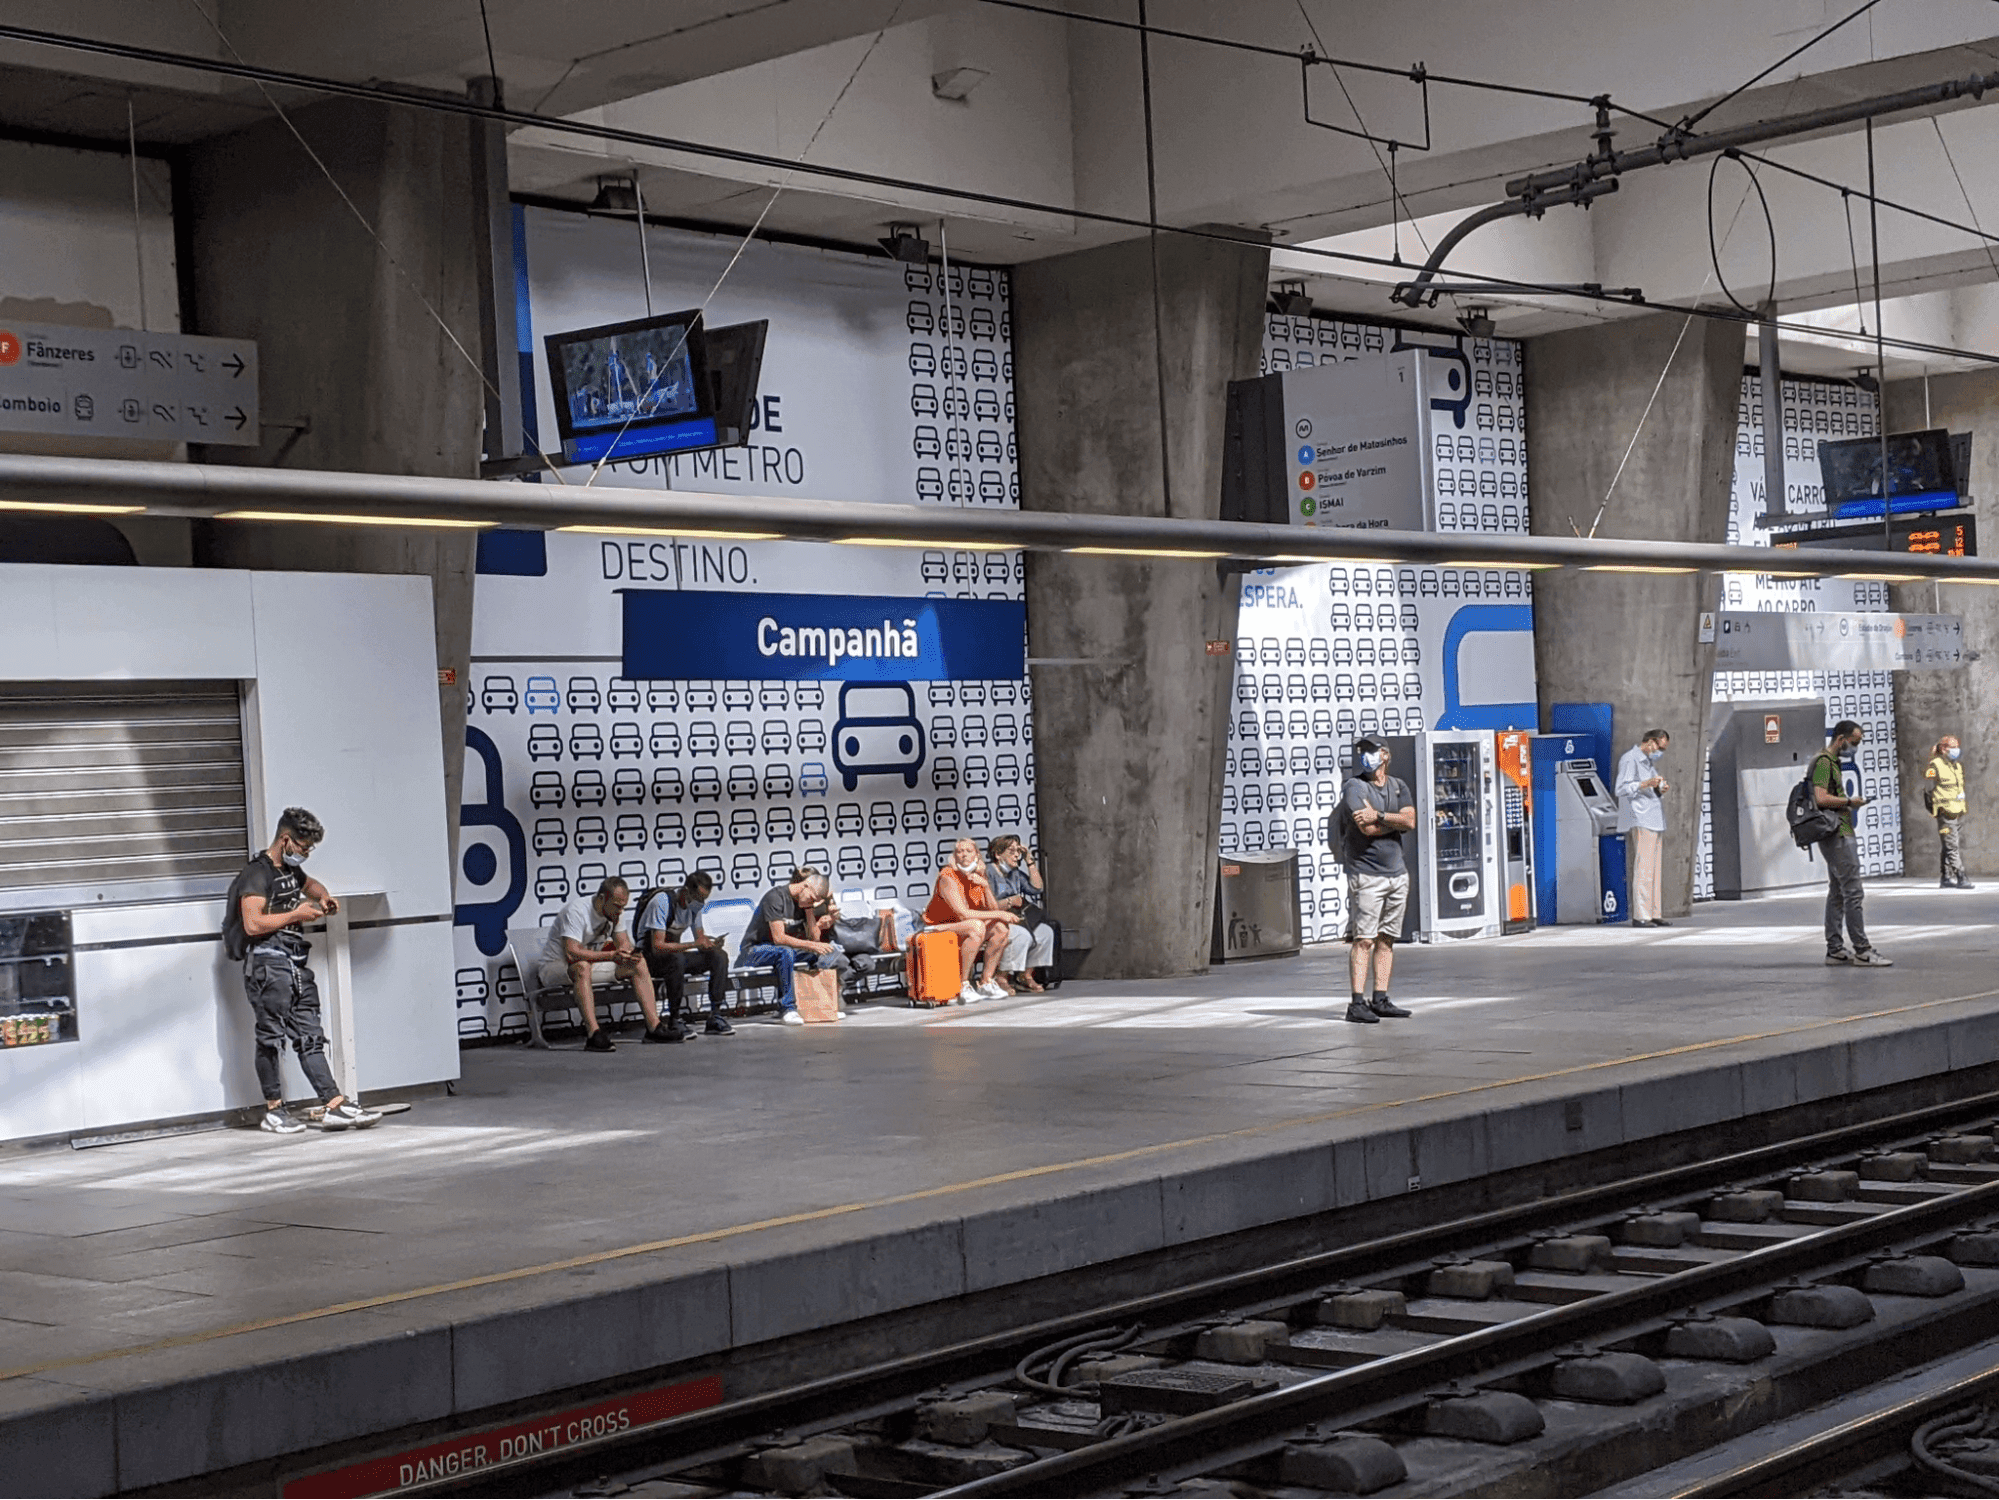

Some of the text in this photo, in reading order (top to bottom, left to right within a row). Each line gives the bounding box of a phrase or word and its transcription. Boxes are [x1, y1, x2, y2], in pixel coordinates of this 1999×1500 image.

[27, 341, 95, 361] Fânzeres
[0, 397, 61, 413] omboio
[1316, 445, 1346, 457] Senhor
[1347, 443, 1358, 452] de
[1360, 437, 1408, 451] Matosinhos
[693, 445, 804, 484] METRO
[1317, 473, 1343, 483] Póvoa
[1344, 470, 1355, 479] de
[1356, 466, 1386, 477] Varzim
[1319, 498, 1344, 509] ISMAI
[1788, 484, 1827, 505] CARRO
[1368, 519, 1389, 528] Hora
[601, 541, 757, 584] DESTINO.
[1239, 585, 1303, 609] SPERA.
[757, 617, 918, 666] Campanhã
[500, 1425, 561, 1460] DON'T
[567, 1408, 630, 1443] CROSS
